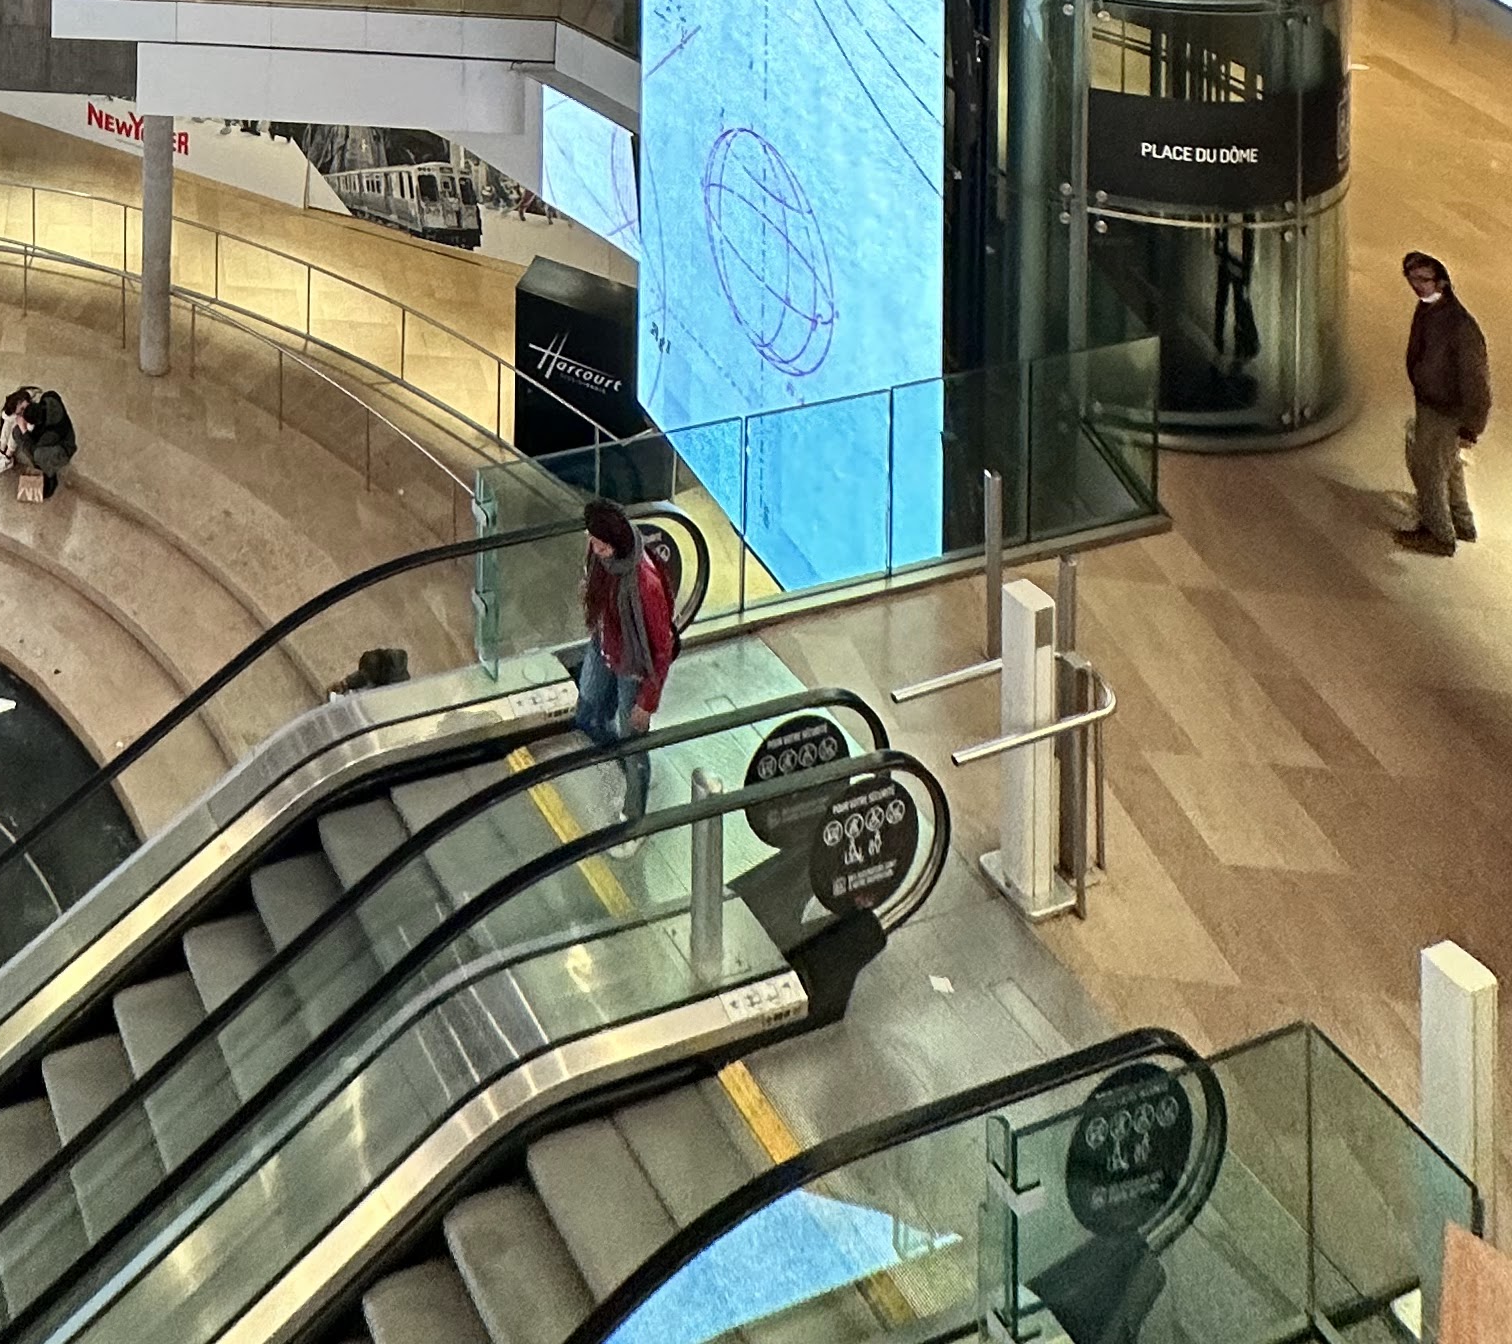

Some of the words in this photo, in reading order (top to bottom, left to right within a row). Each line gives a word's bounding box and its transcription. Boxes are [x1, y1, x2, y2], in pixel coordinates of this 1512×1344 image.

[1140, 141, 1193, 162] PLACE
[1195, 146, 1217, 164] DU
[1219, 145, 1259, 164] DÔME
[528, 330, 623, 393] Harcourt
